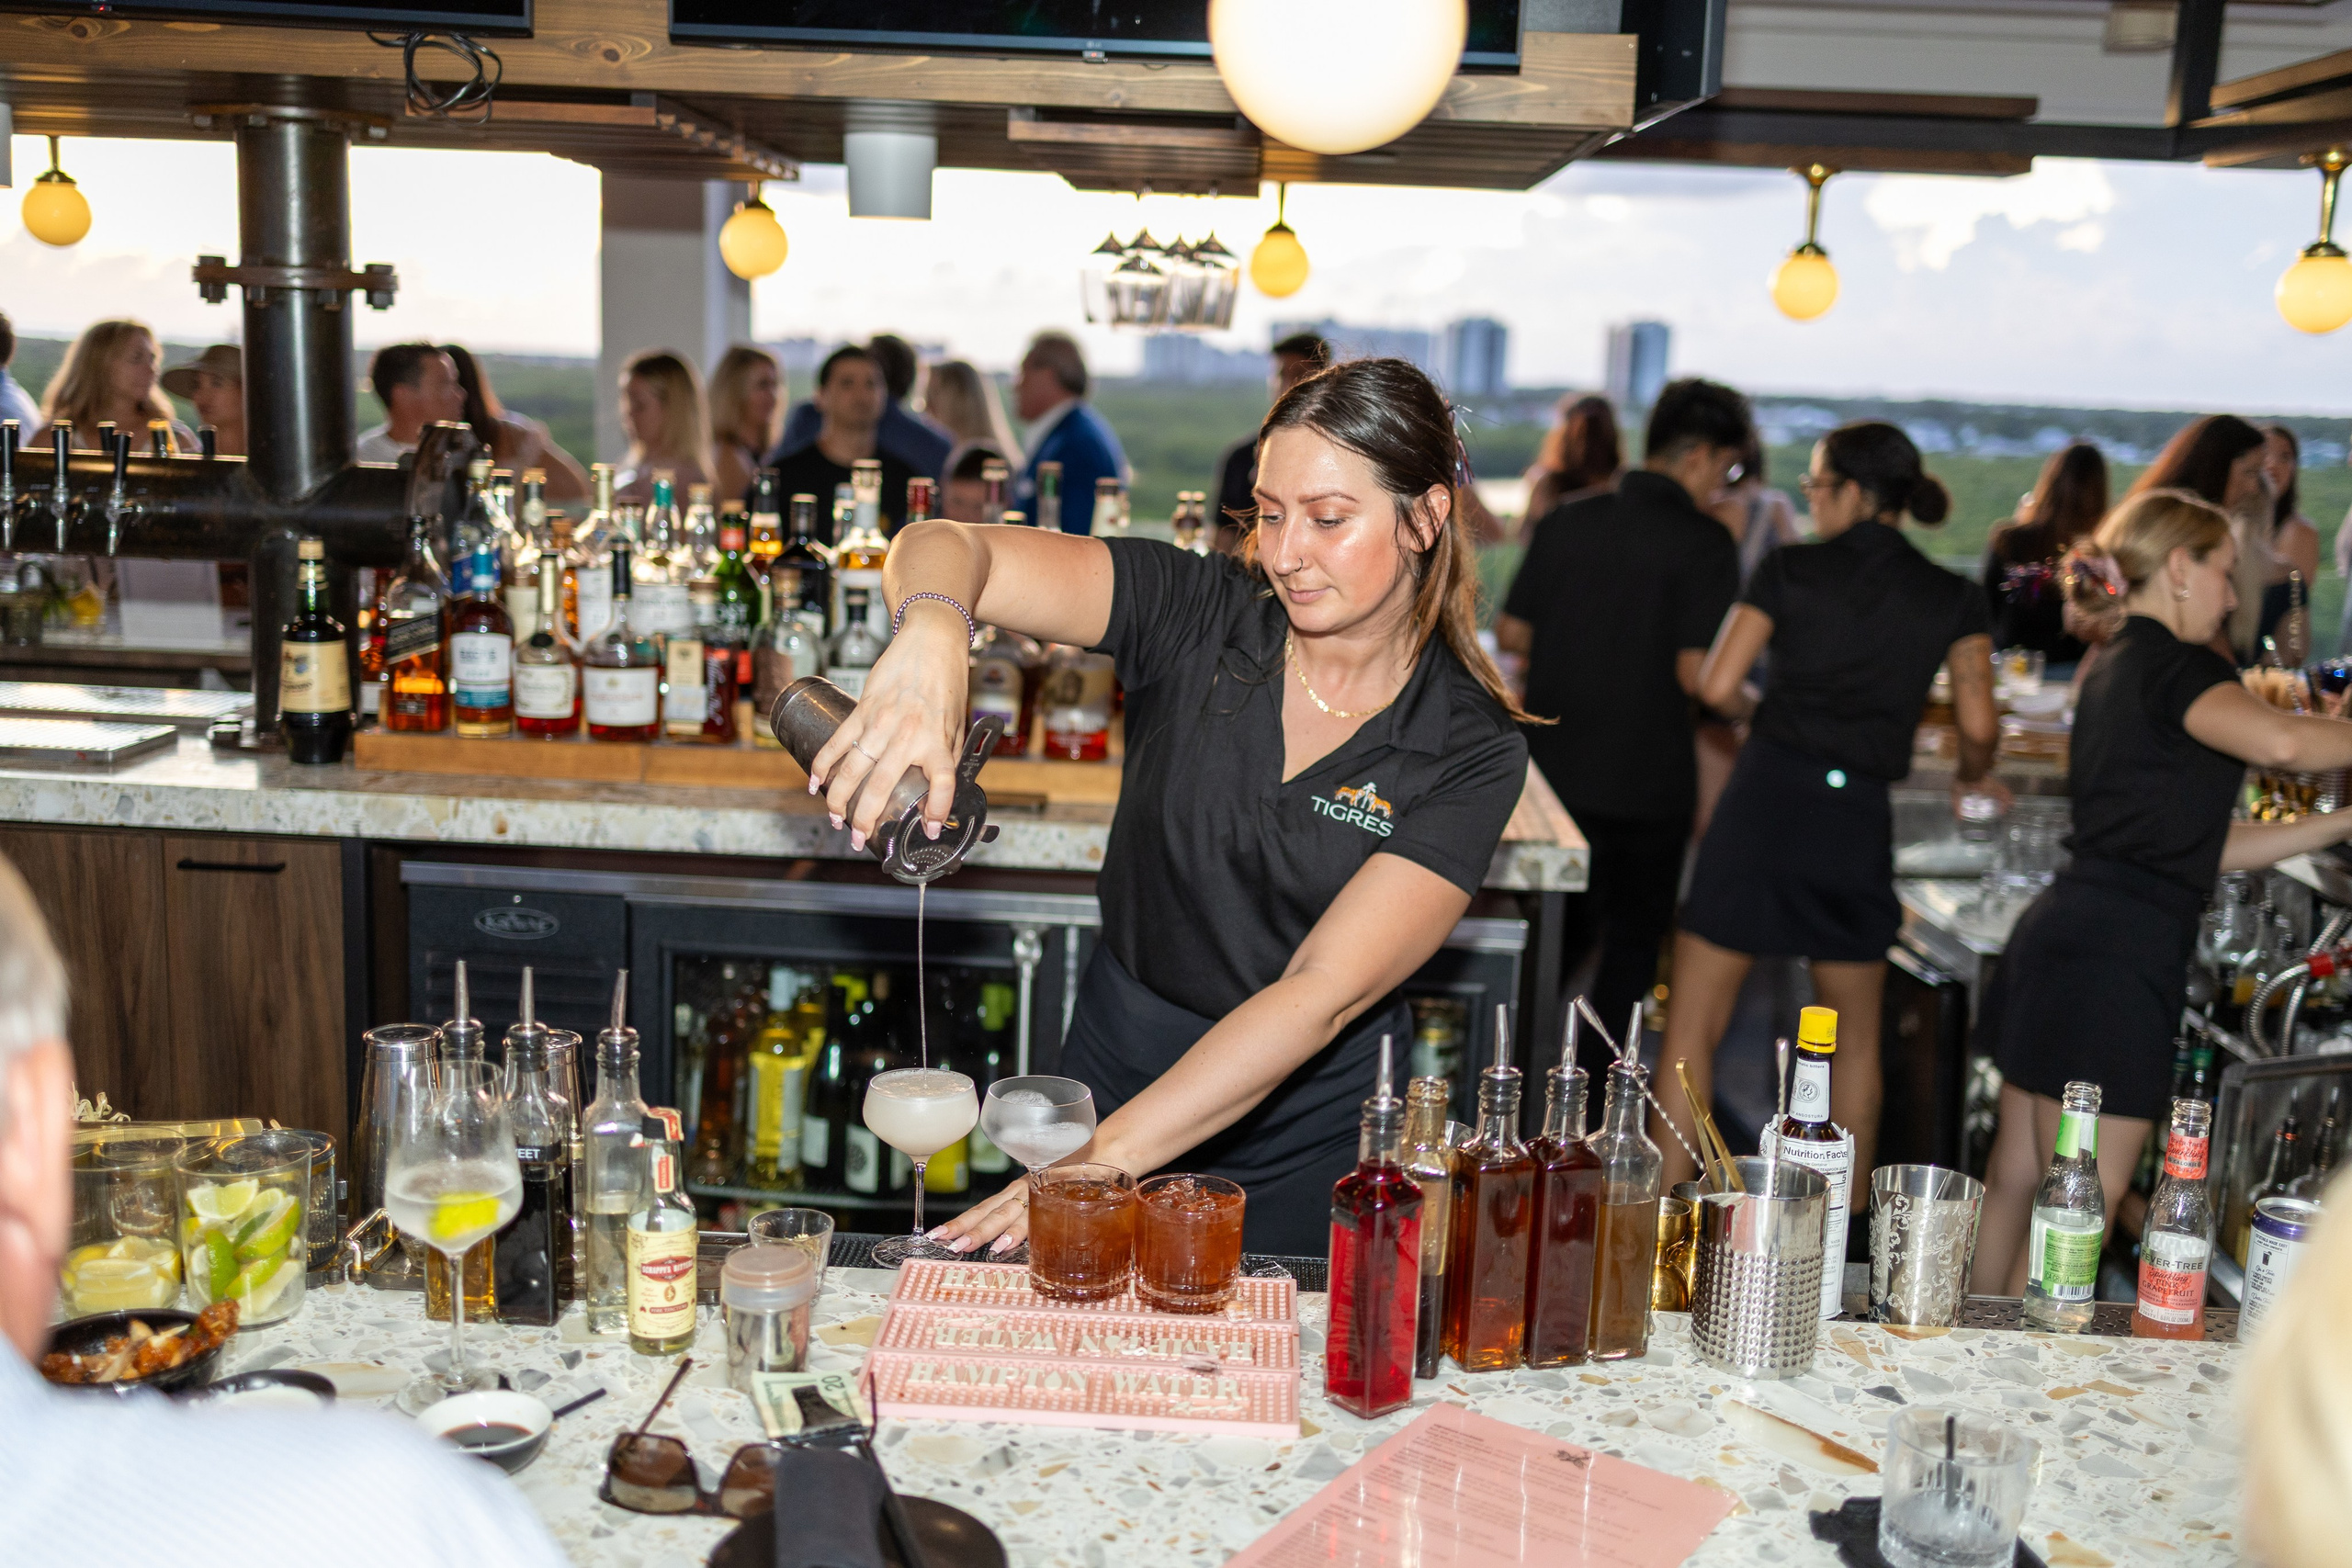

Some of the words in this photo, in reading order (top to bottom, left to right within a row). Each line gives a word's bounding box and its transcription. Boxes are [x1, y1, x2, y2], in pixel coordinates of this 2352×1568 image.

[1311, 795, 1394, 837] TIGRES
[515, 1148, 540, 1158] EET
[1783, 1145, 1825, 1159] Nutrition
[1826, 1150, 1848, 1159] Facts
[2142, 1250, 2203, 1269] FEVER-TREE
[2149, 1269, 2188, 1284] Sparkling
[2155, 1278, 2178, 1289] PINK
[2142, 1280, 2195, 1297] GRAPEFRUIT
[934, 1327, 1057, 1350] WATER
[907, 1362, 1091, 1392] HAMPTON
[1112, 1371, 1249, 1400] WATER
